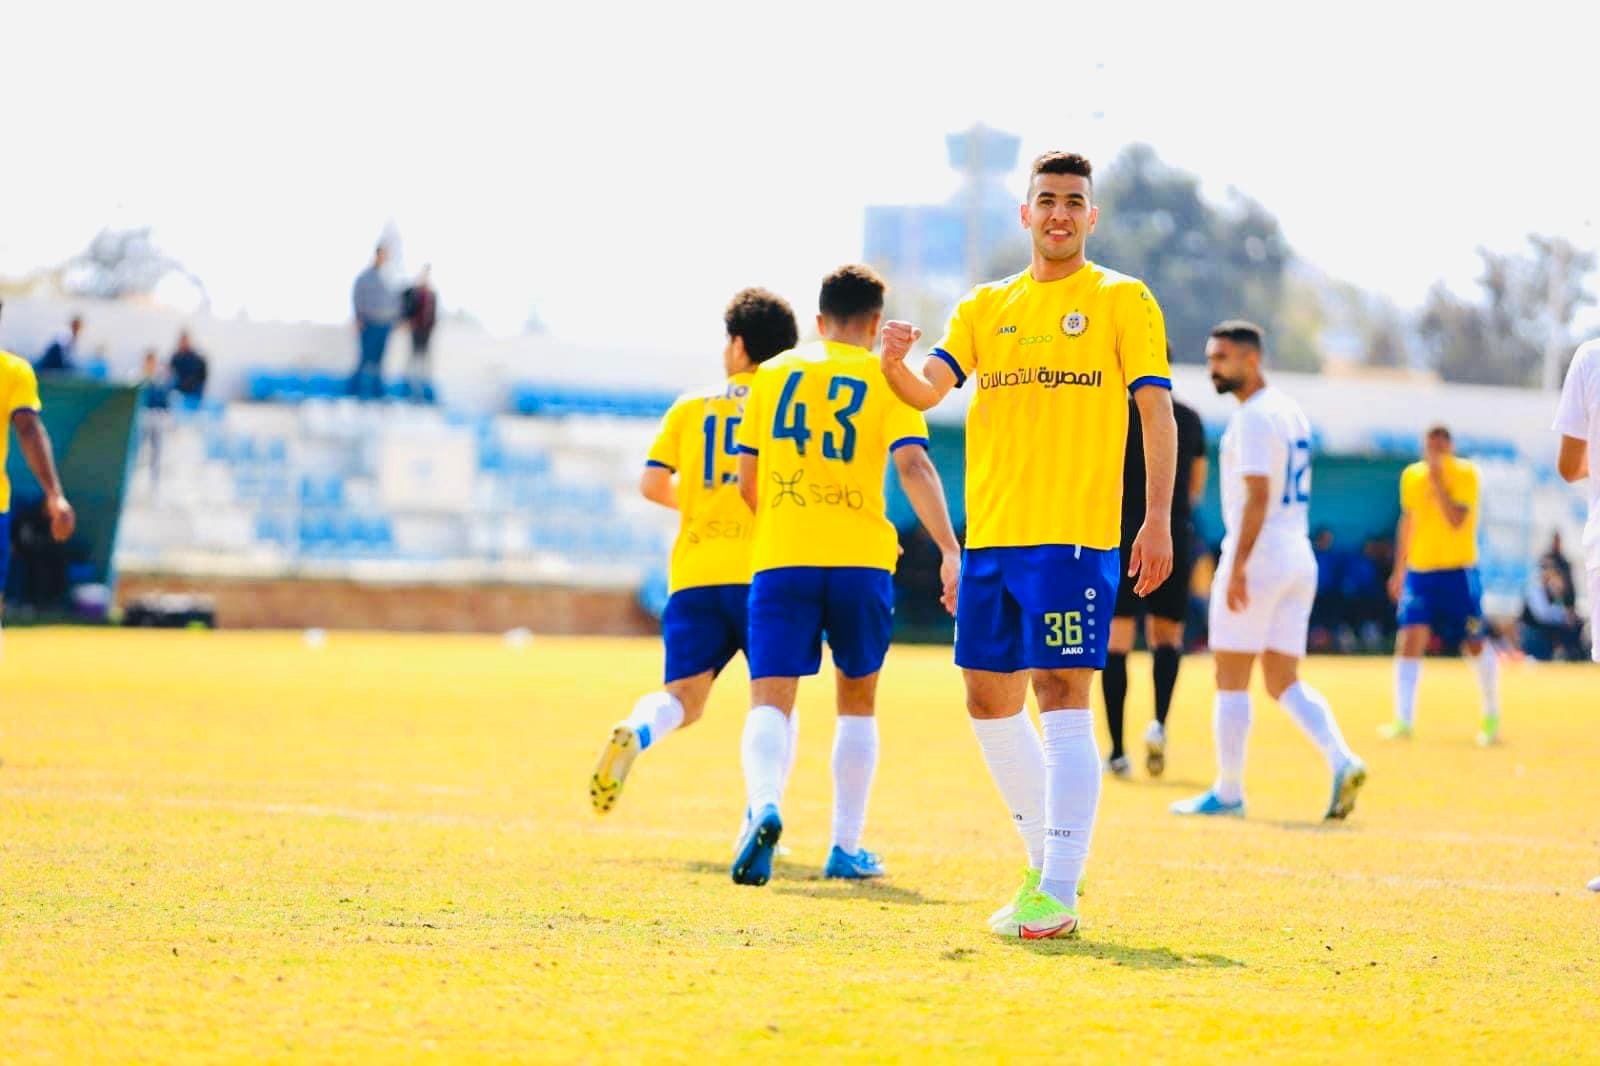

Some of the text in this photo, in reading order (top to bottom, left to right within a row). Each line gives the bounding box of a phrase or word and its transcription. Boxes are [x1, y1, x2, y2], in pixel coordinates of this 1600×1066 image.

[1037, 366, 1102, 388] المصرية
[772, 370, 868, 463] 43
[1044, 611, 1083, 647] 36
[1060, 646, 1084, 655] JAKO
